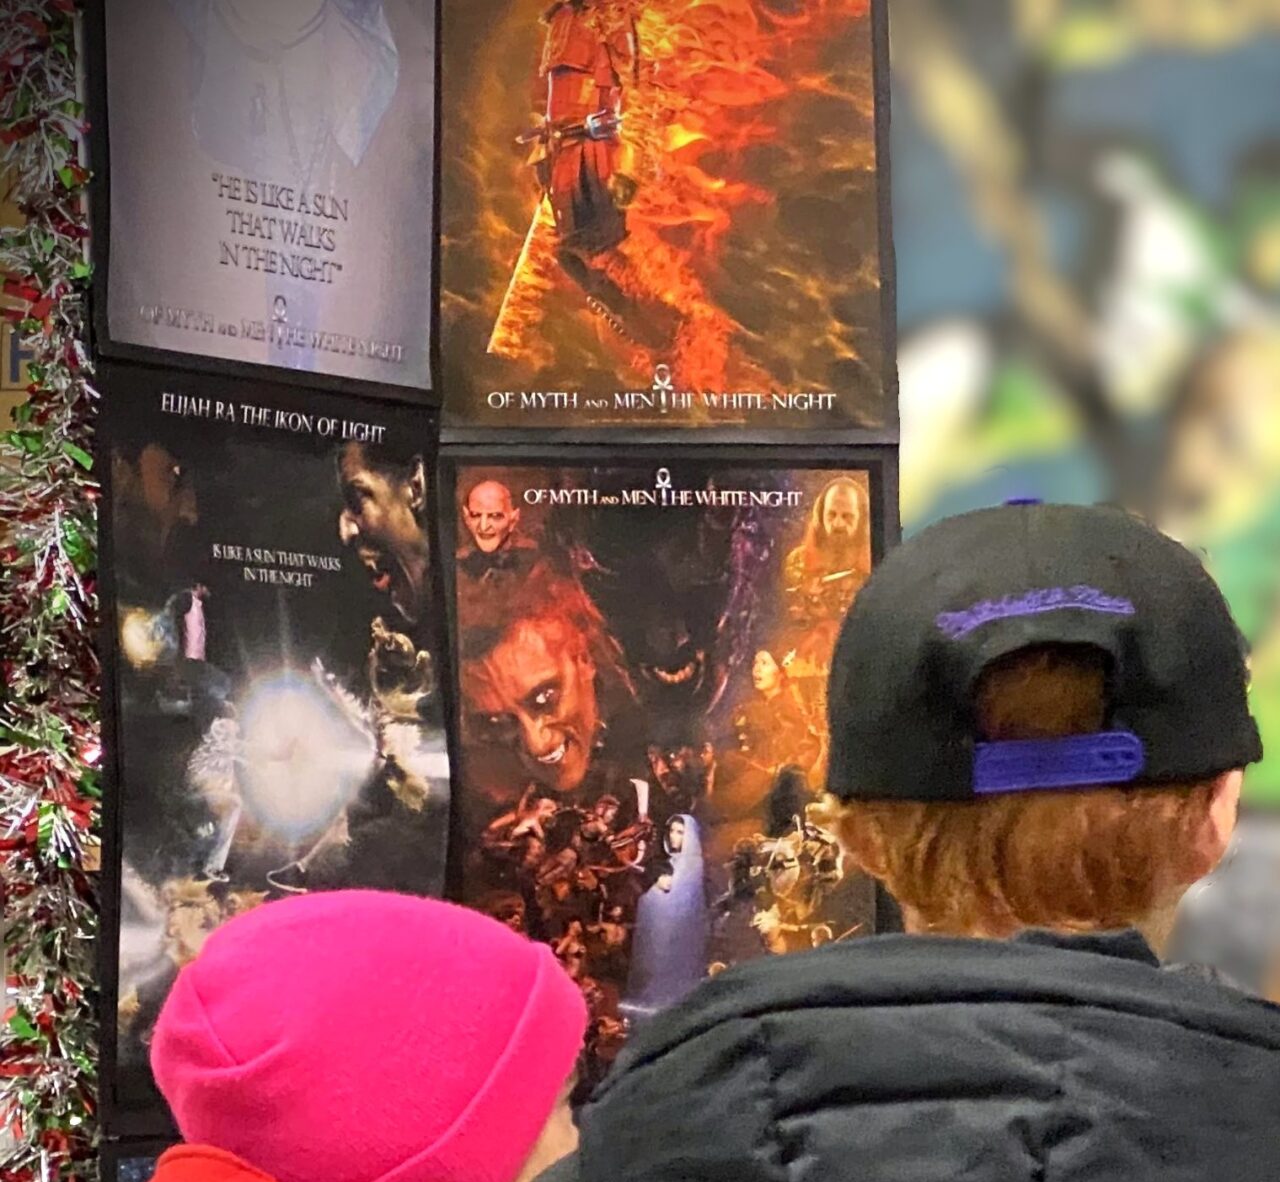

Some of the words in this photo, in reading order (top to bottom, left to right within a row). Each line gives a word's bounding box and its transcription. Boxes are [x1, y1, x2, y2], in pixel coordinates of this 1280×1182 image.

[244, 179, 260, 203] IS
[260, 185, 294, 211] LIKE
[296, 194, 312, 214] A
[312, 193, 348, 221] SUN
[226, 210, 277, 240] THAT
[279, 219, 336, 251] WALKS
[220, 241, 239, 266] IN
[243, 249, 277, 275] THE
[487, 391, 515, 408] OF
[520, 391, 577, 409] MYTH
[584, 400, 608, 408] AND
[614, 392, 655, 410] MEN
[702, 392, 768, 409] WHITE
[771, 392, 836, 410] NIGHT
[162, 393, 211, 417] ELIJAH
[216, 402, 235, 422] RA
[241, 405, 271, 427] THE
[274, 411, 312, 433] IKON
[318, 417, 337, 436] OF
[341, 419, 386, 444] LIGHT
[524, 489, 547, 505] OF
[548, 489, 597, 505] MYTH
[600, 496, 619, 505] AND
[622, 491, 656, 506] MEN
[694, 491, 750, 506] WHITE
[749, 492, 802, 507] NIGHT
[223, 545, 243, 560] LIKE
[245, 548, 252, 561] A
[253, 548, 276, 563] SUN
[277, 551, 306, 566] THAT
[306, 555, 341, 571] WALKS
[243, 567, 256, 581] IN
[258, 568, 279, 584] THE
[279, 571, 314, 587] NIGHT
